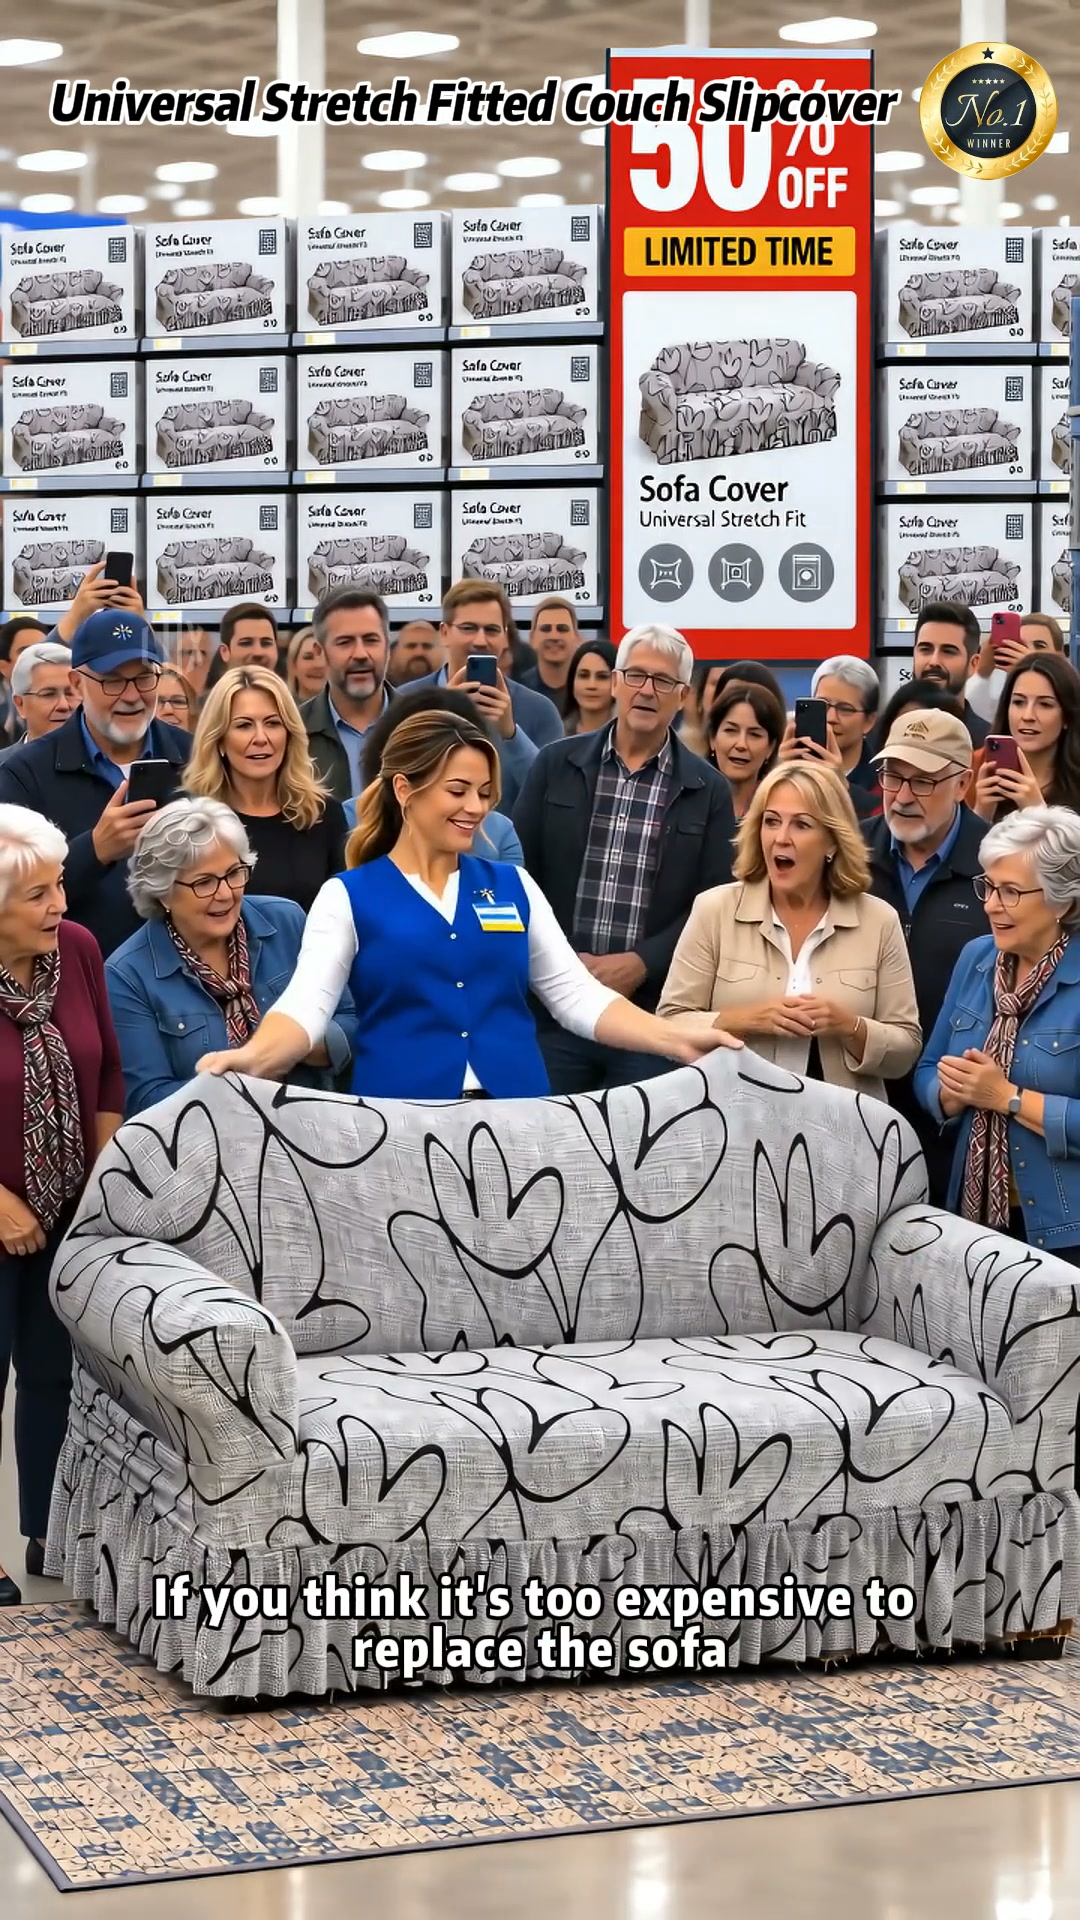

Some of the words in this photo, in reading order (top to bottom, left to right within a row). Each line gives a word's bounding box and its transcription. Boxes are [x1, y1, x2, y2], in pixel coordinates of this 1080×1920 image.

[777, 165, 849, 210] OFF
[645, 236, 757, 266] LIMITED
[764, 236, 833, 266] TIME
[639, 474, 700, 502] Sofa
[708, 475, 789, 502] Cover
[639, 510, 715, 527] Universal
[721, 509, 780, 527] Stretch
[785, 510, 807, 527] Fit
